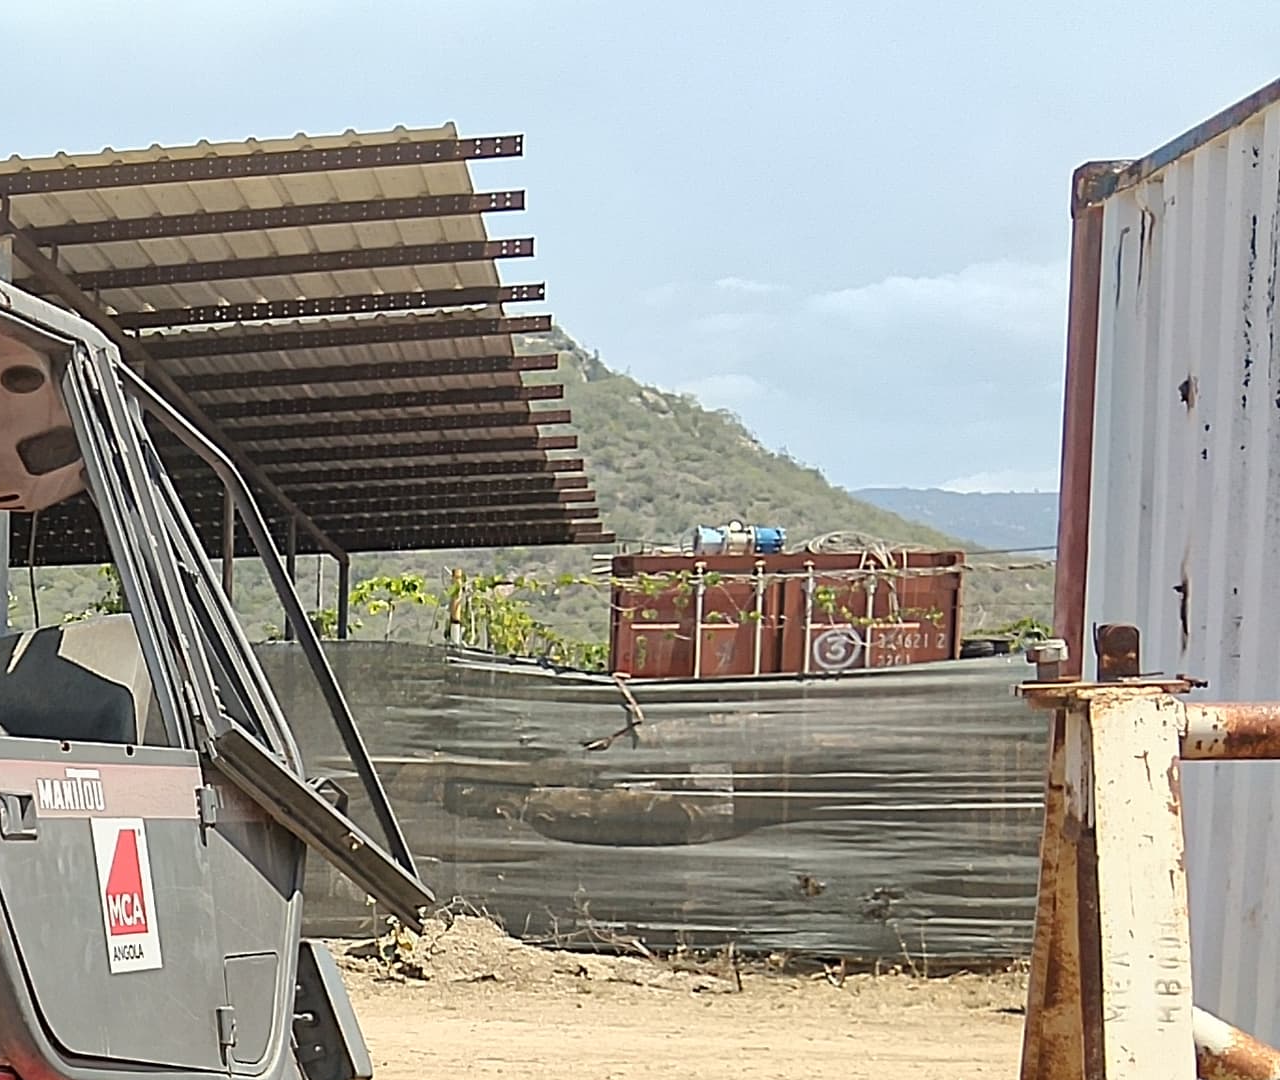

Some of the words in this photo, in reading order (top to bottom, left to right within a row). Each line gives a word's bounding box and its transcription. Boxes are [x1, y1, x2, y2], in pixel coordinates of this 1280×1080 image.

[36, 767, 105, 812] MANITOU
[107, 893, 146, 928] MCA
[113, 944, 144, 962] ANGOLA
